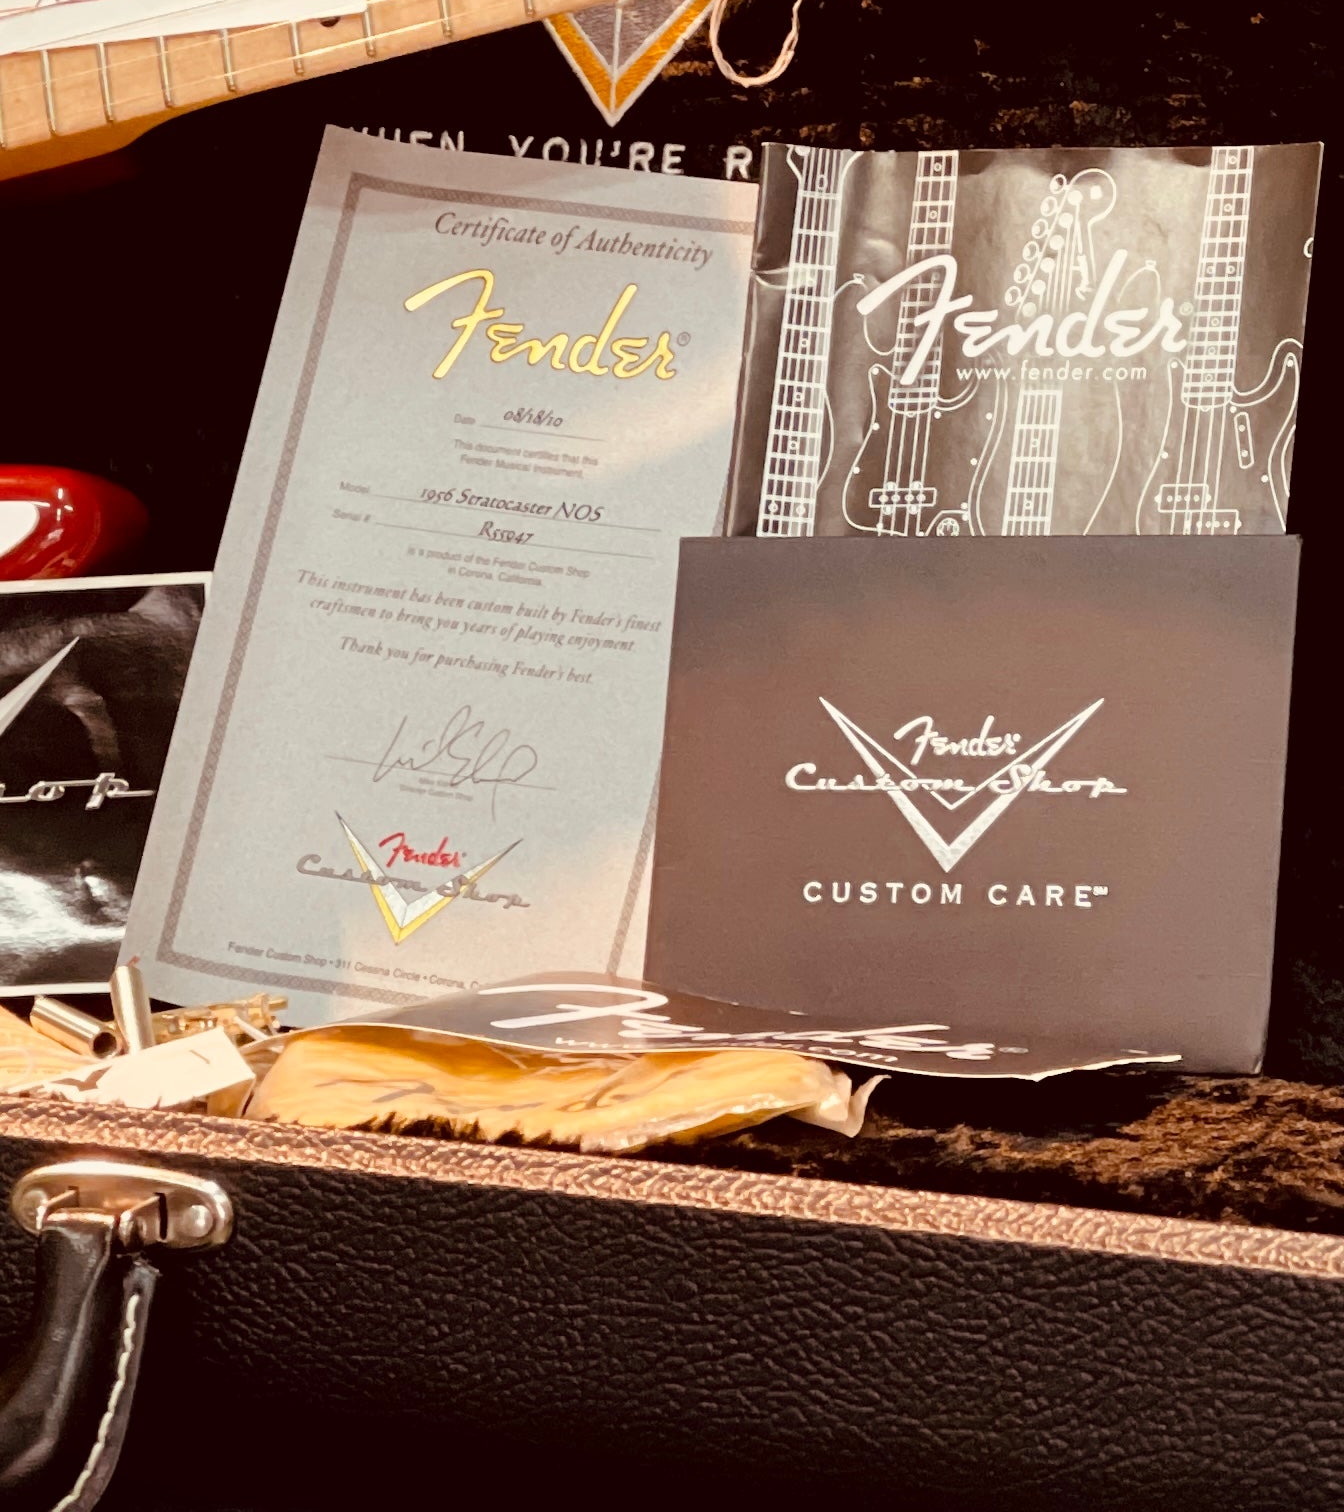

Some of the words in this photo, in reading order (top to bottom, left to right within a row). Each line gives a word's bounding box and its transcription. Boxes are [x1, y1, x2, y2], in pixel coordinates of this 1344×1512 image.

[508, 134, 686, 175] YOU'RE
[434, 211, 547, 247] Certificate
[550, 225, 579, 254] of
[574, 228, 714, 271] Authenticity
[404, 268, 678, 380] Fender
[856, 248, 1188, 385] Fender
[955, 358, 1148, 382] www.fender.com
[503, 407, 564, 427] 08/18/10
[420, 487, 457, 504] 1956
[456, 488, 553, 516] Stratocaster
[554, 501, 605, 522] NOS
[297, 568, 329, 589] This
[331, 576, 407, 601] instrument
[408, 587, 433, 603] has
[434, 591, 465, 609] been
[467, 599, 514, 616] custom
[515, 602, 549, 620] built
[551, 606, 568, 625] by
[570, 608, 622, 628] Fender's
[622, 614, 662, 633] finest
[309, 597, 377, 618] craftsmen
[378, 608, 393, 622] to
[396, 607, 433, 631] bring
[433, 616, 460, 632] you
[459, 619, 497, 635] years
[499, 621, 516, 640] of
[513, 625, 566, 647] playing
[340, 635, 384, 656] Thank
[384, 646, 410, 661] you
[409, 646, 434, 666] for
[433, 653, 510, 678] purchasing
[512, 660, 565, 680] Fender's
[893, 714, 1021, 766] Fender
[784, 762, 976, 793] Custom
[988, 763, 1128, 799] Shop
[378, 831, 461, 868] Fender
[296, 853, 428, 893] Custom
[436, 874, 531, 910] Shop
[802, 881, 963, 906] CUSTOM
[227, 941, 264, 957] Fender
[266, 948, 302, 963] Custom
[303, 953, 328, 968] Shop
